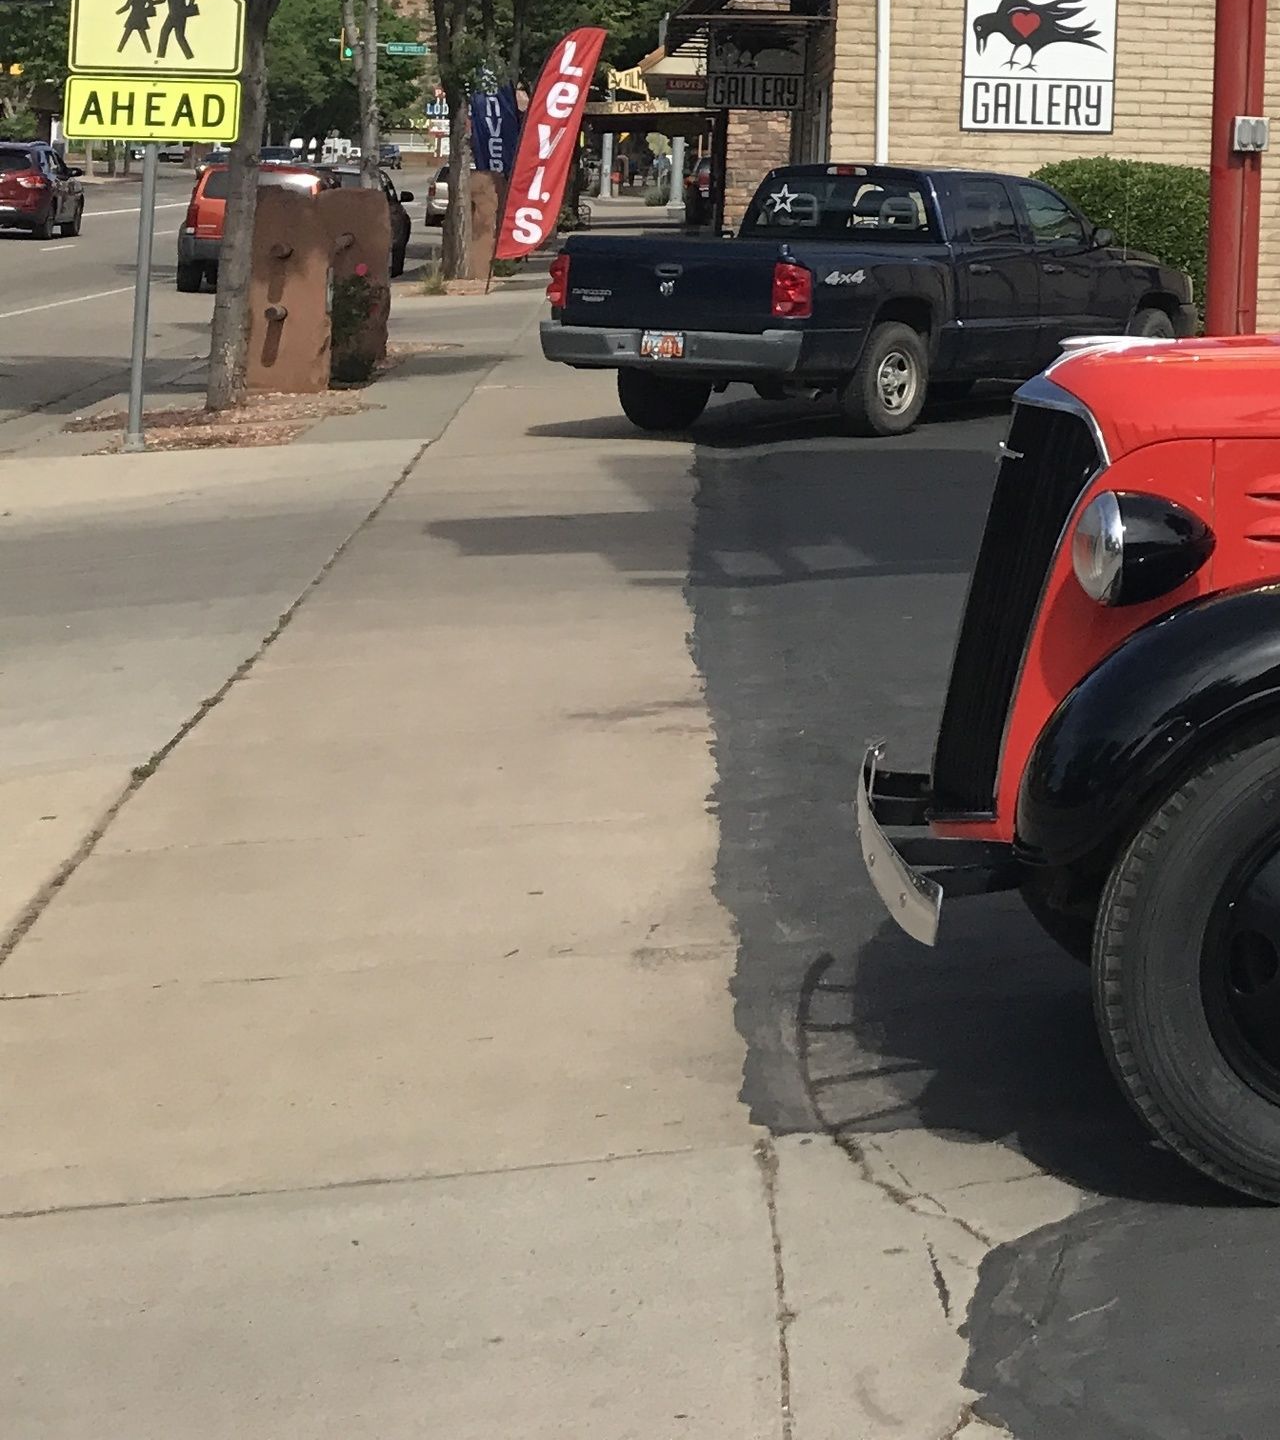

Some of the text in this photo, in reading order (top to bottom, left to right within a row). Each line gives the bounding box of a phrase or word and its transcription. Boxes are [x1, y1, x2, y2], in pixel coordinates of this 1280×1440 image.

[713, 75, 798, 106] GALLERY
[972, 81, 1102, 126] GALLERY
[79, 90, 226, 128] AHEAD
[824, 269, 867, 286] 4x4
